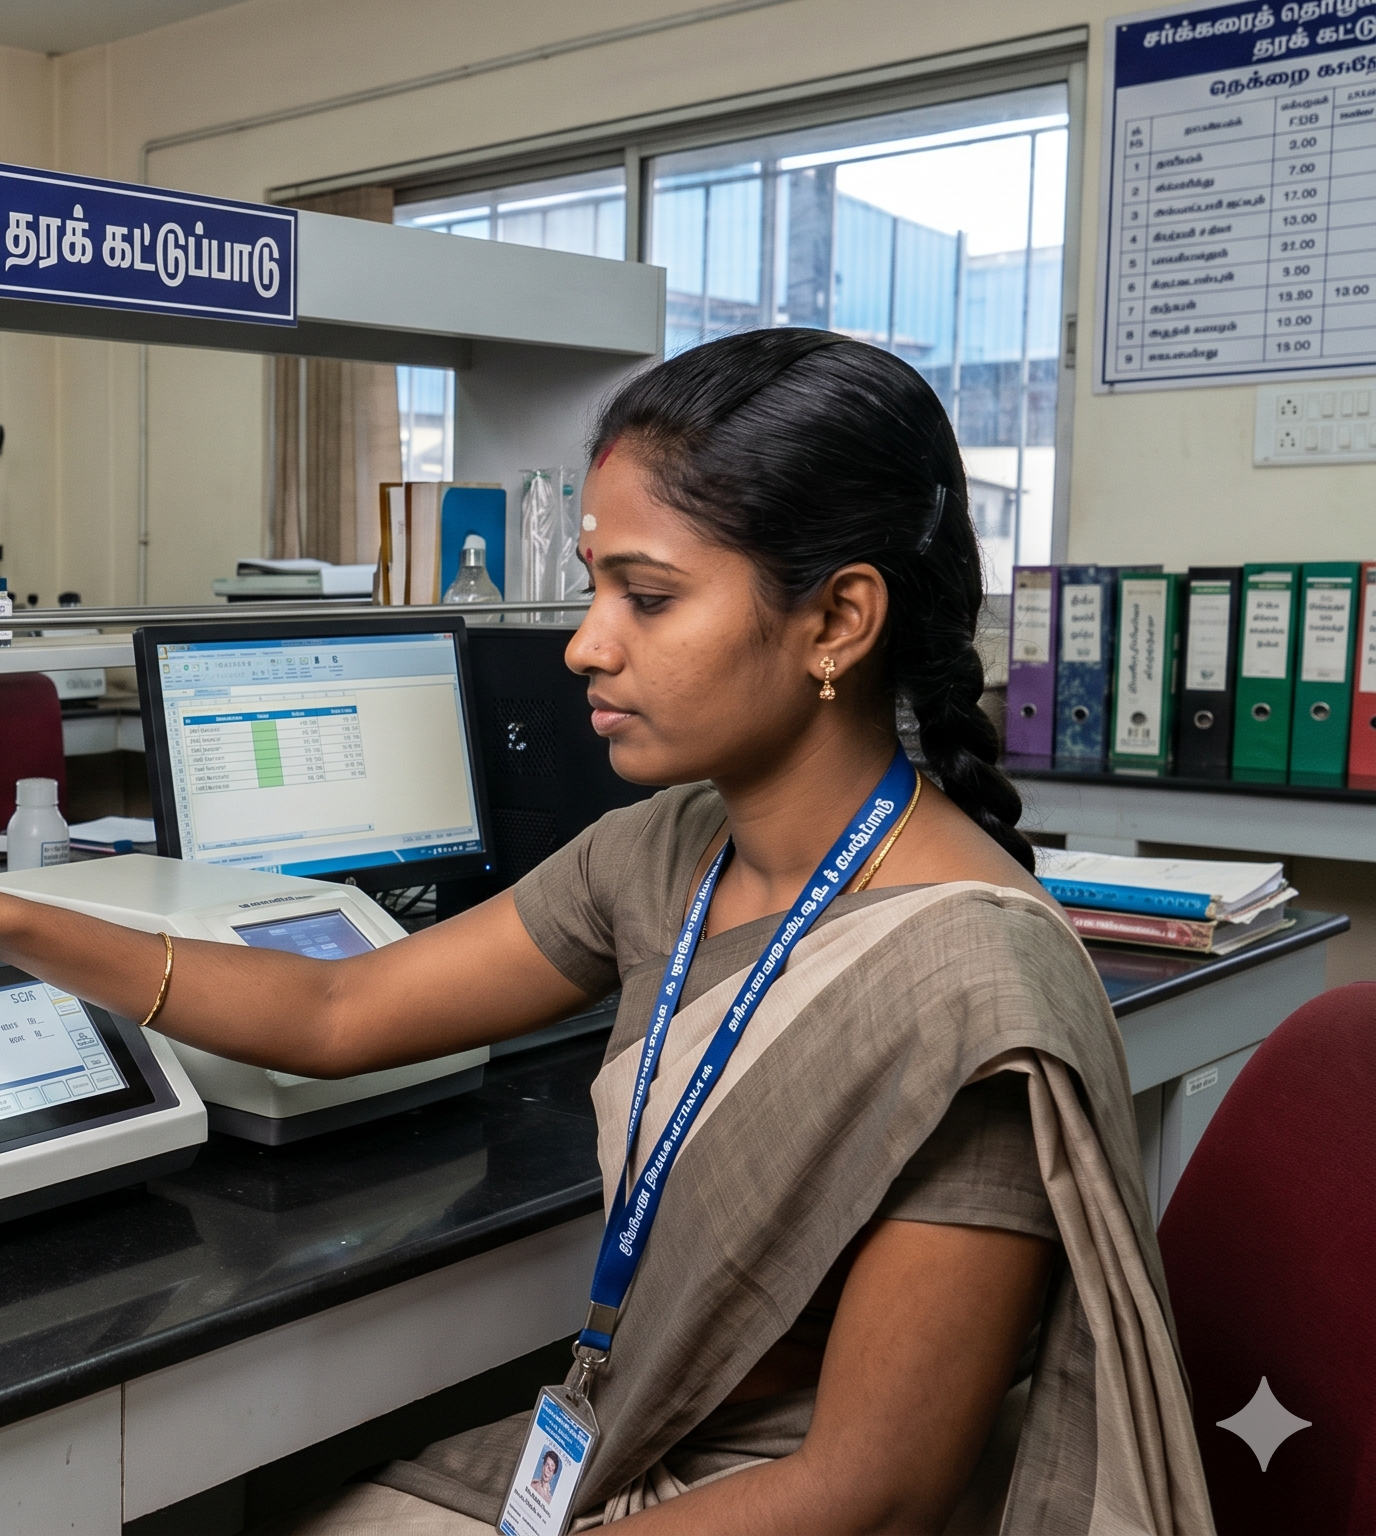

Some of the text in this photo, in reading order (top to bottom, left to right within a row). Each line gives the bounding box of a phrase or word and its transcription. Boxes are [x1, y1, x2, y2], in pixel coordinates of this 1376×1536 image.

[1252, 26, 1310, 61] தரக்
[5, 204, 93, 272] தரக்
[102, 221, 280, 298] கட்டுப்பாடு
